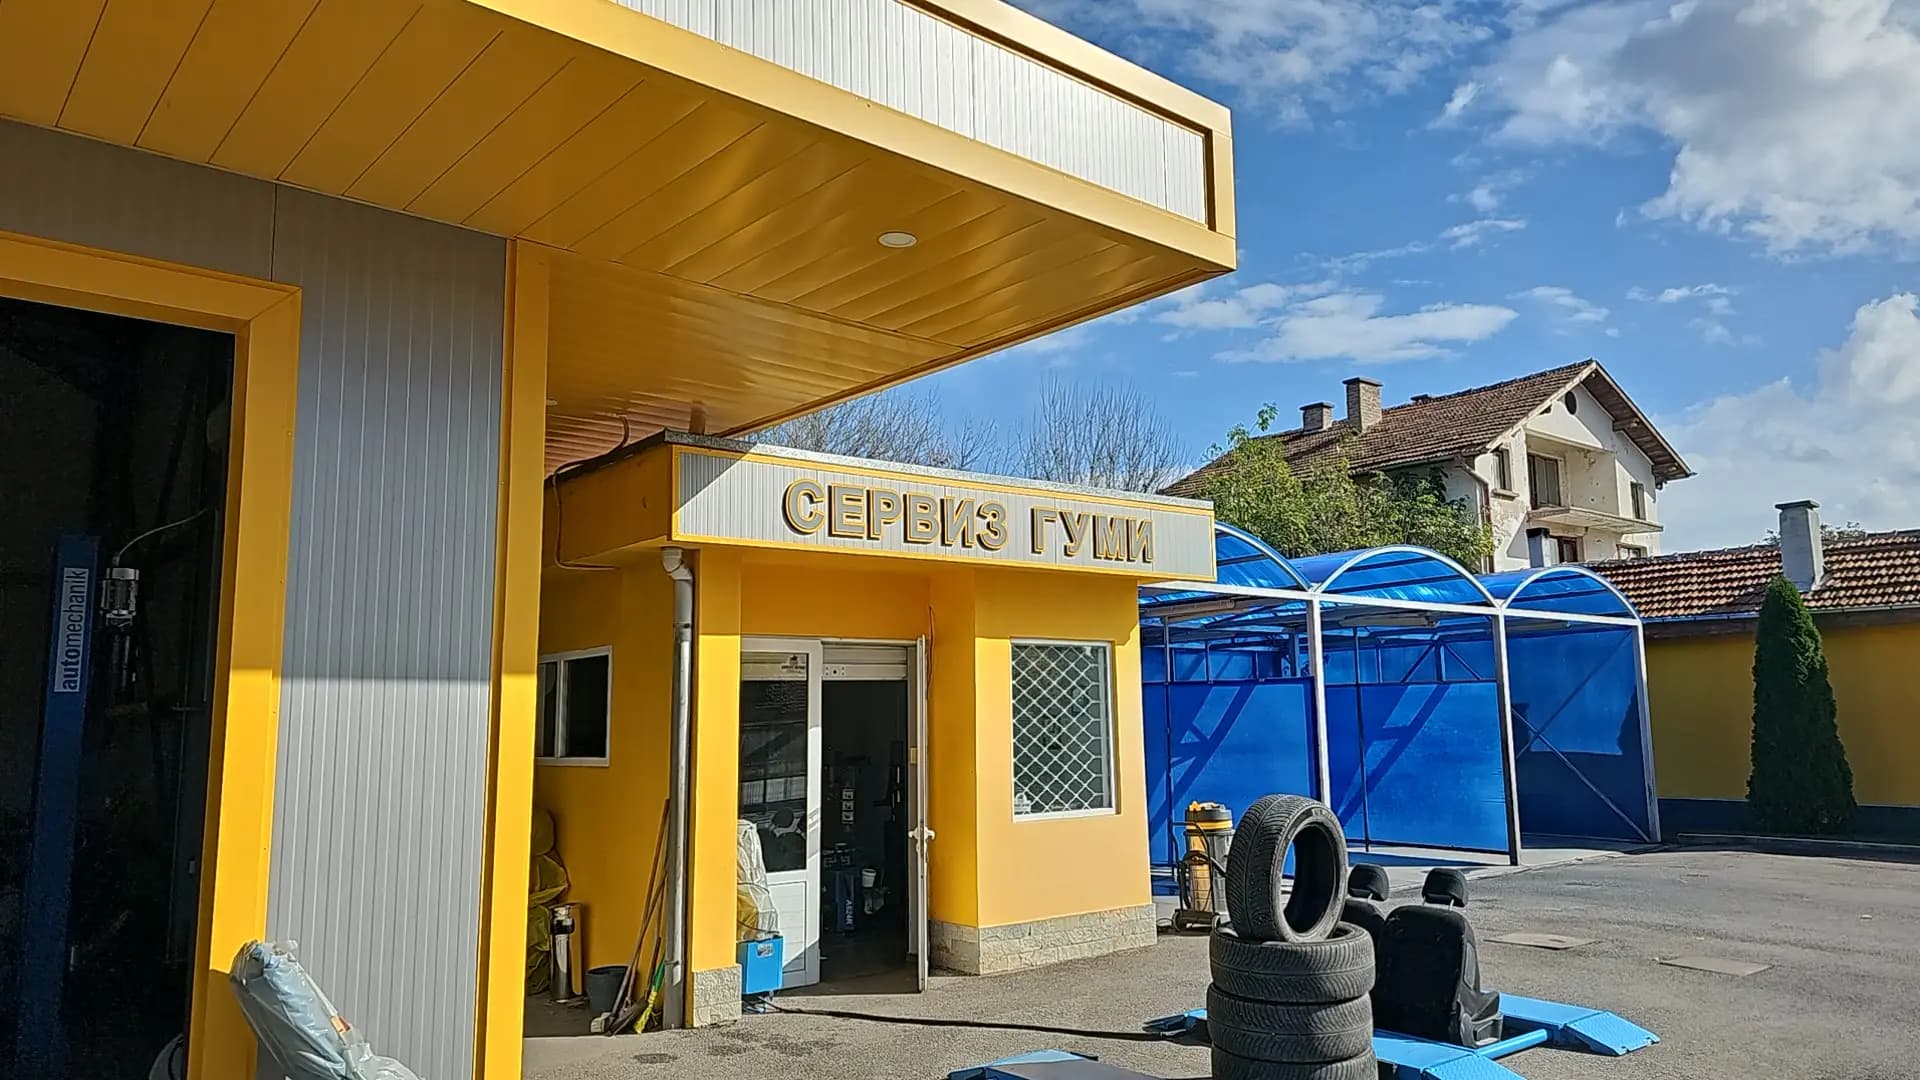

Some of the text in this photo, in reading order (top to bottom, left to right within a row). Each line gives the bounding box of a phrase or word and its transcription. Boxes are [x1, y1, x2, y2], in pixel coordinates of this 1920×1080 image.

[783, 478, 1154, 563] СЕРВИЗ ГУМИ
[61, 570, 87, 690] automechanik
